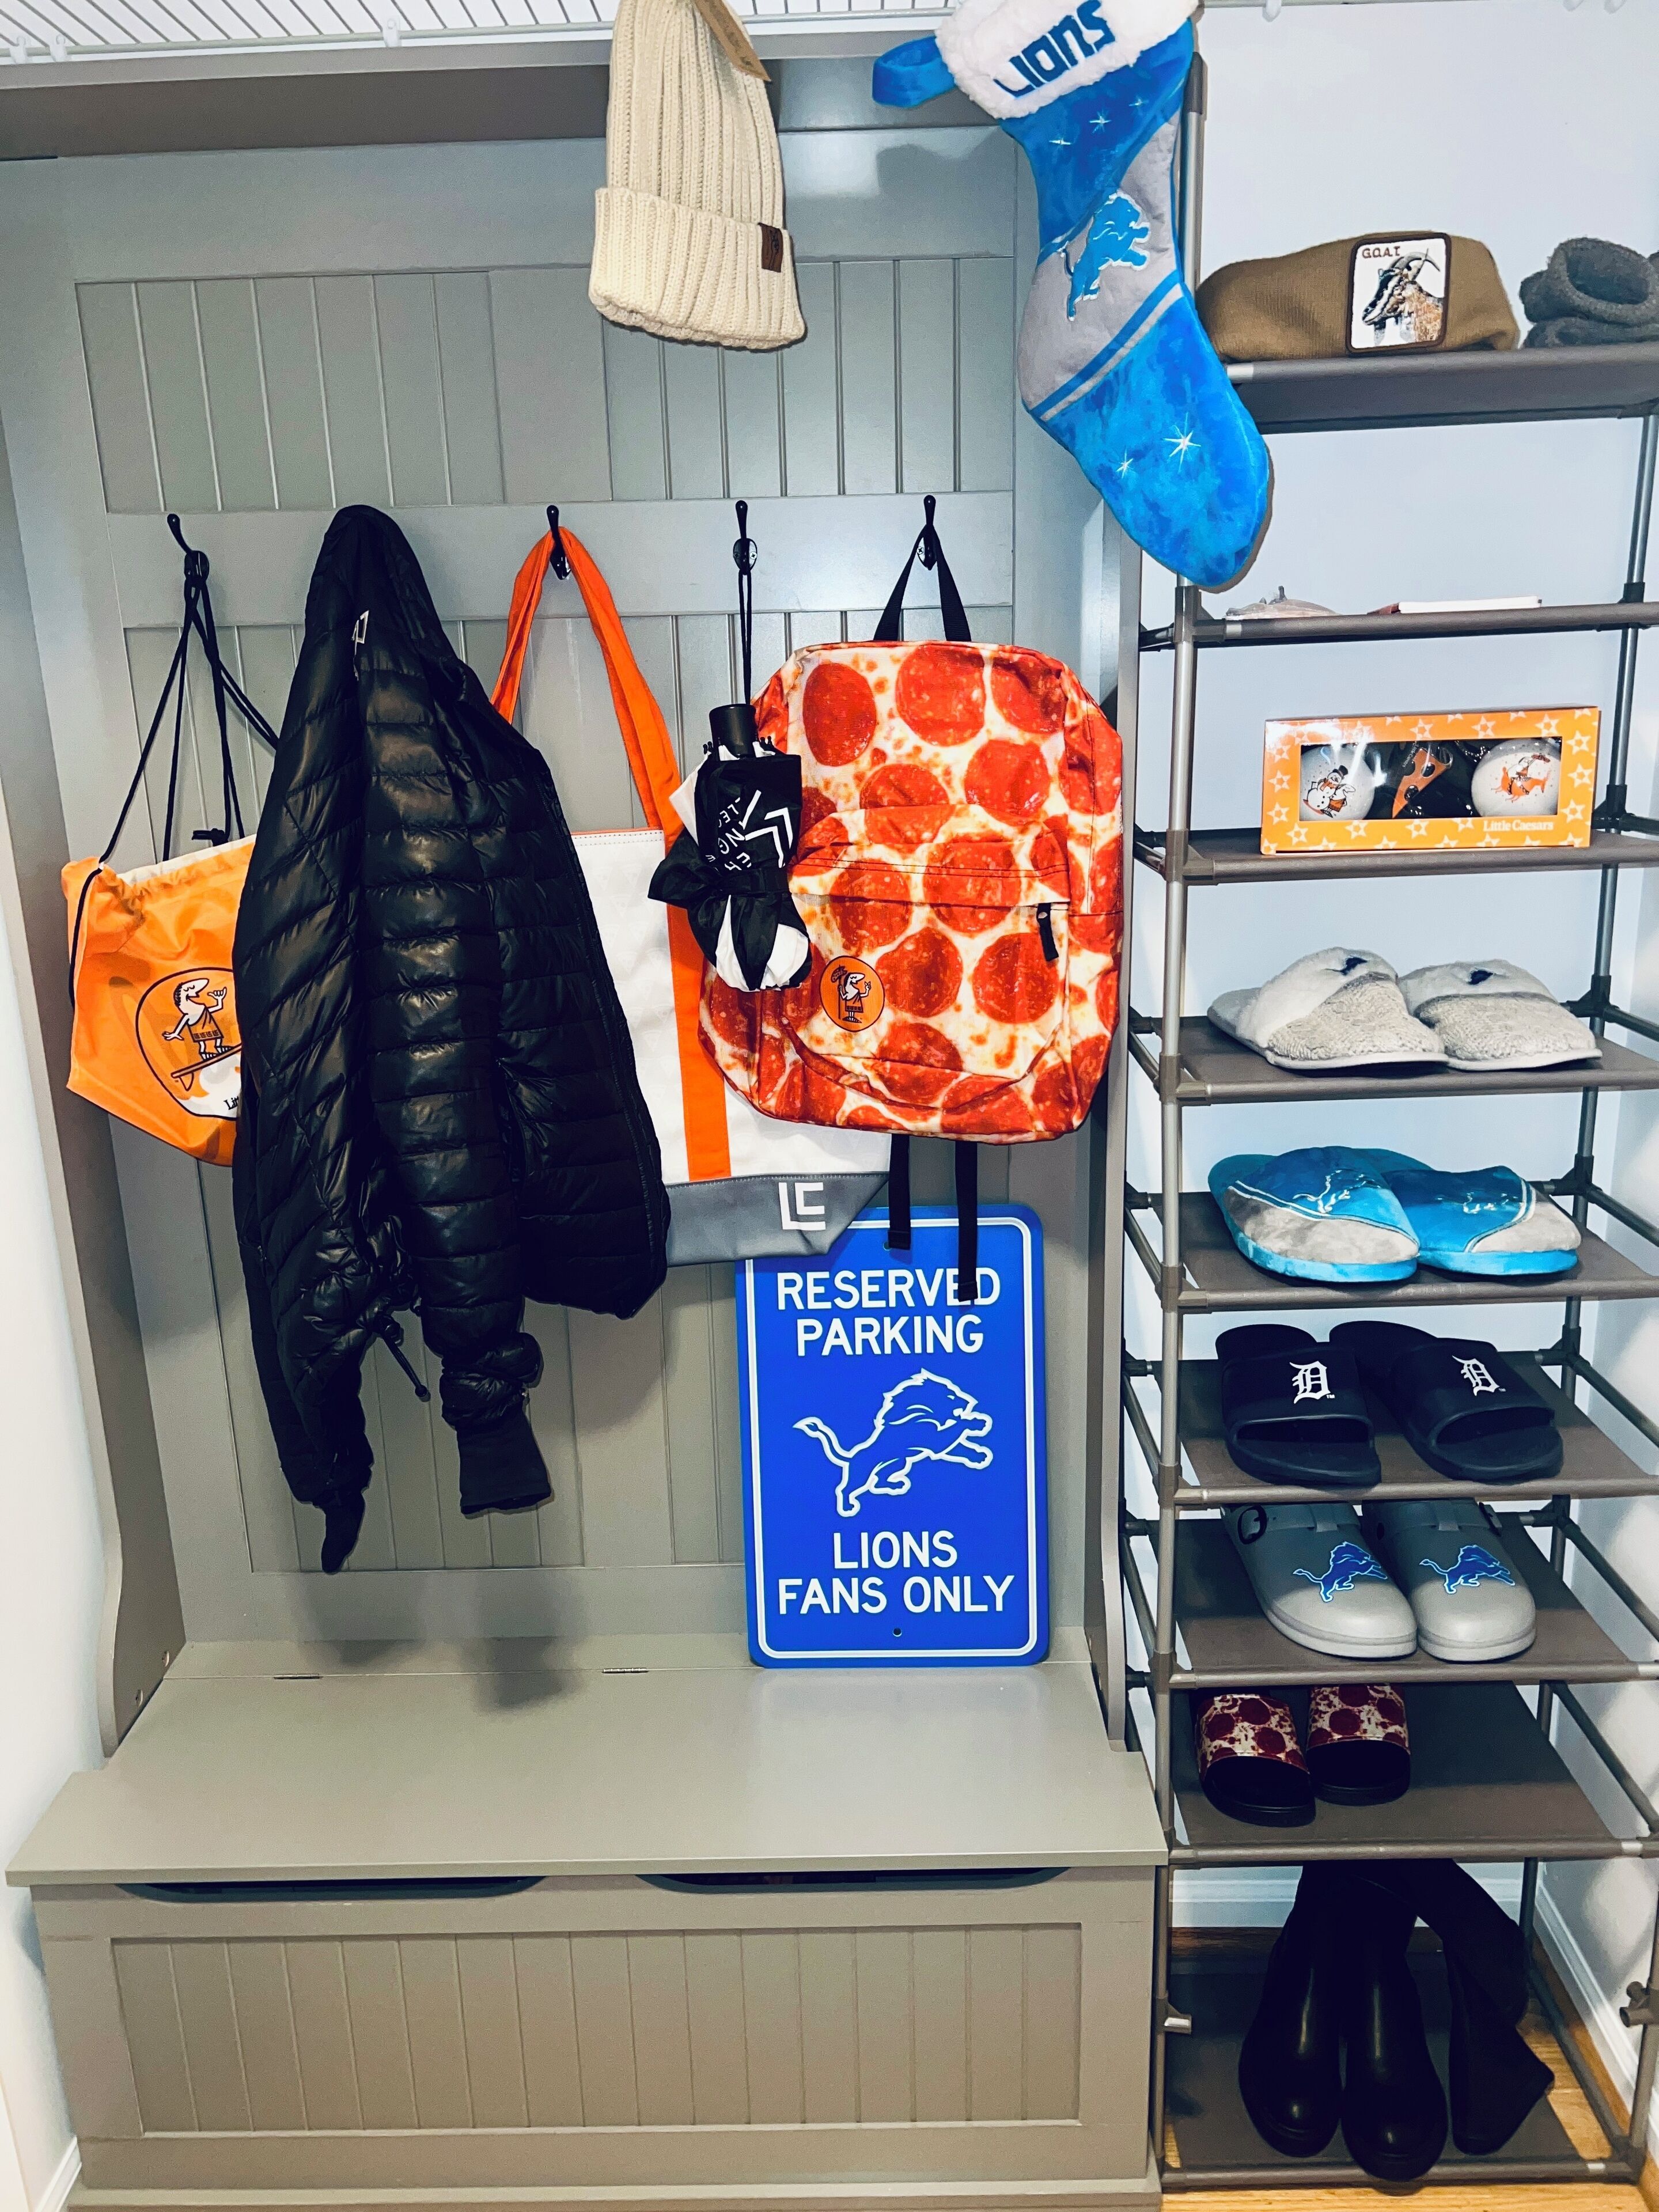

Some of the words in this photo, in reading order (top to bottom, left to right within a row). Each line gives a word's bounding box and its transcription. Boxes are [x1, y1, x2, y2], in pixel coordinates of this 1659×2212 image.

[993, 0, 1116, 98] LIONS
[1483, 820, 1511, 832] Little
[1512, 819, 1554, 831] Caesars
[777, 1267, 1001, 1310] RESERVED
[797, 1313, 984, 1357] PARKING
[1289, 1360, 1331, 1404] D
[1452, 1355, 1500, 1396] D
[833, 1529, 958, 1569] LIONS
[778, 1576, 888, 1615] FANS
[903, 1574, 1015, 1613] ONLY
